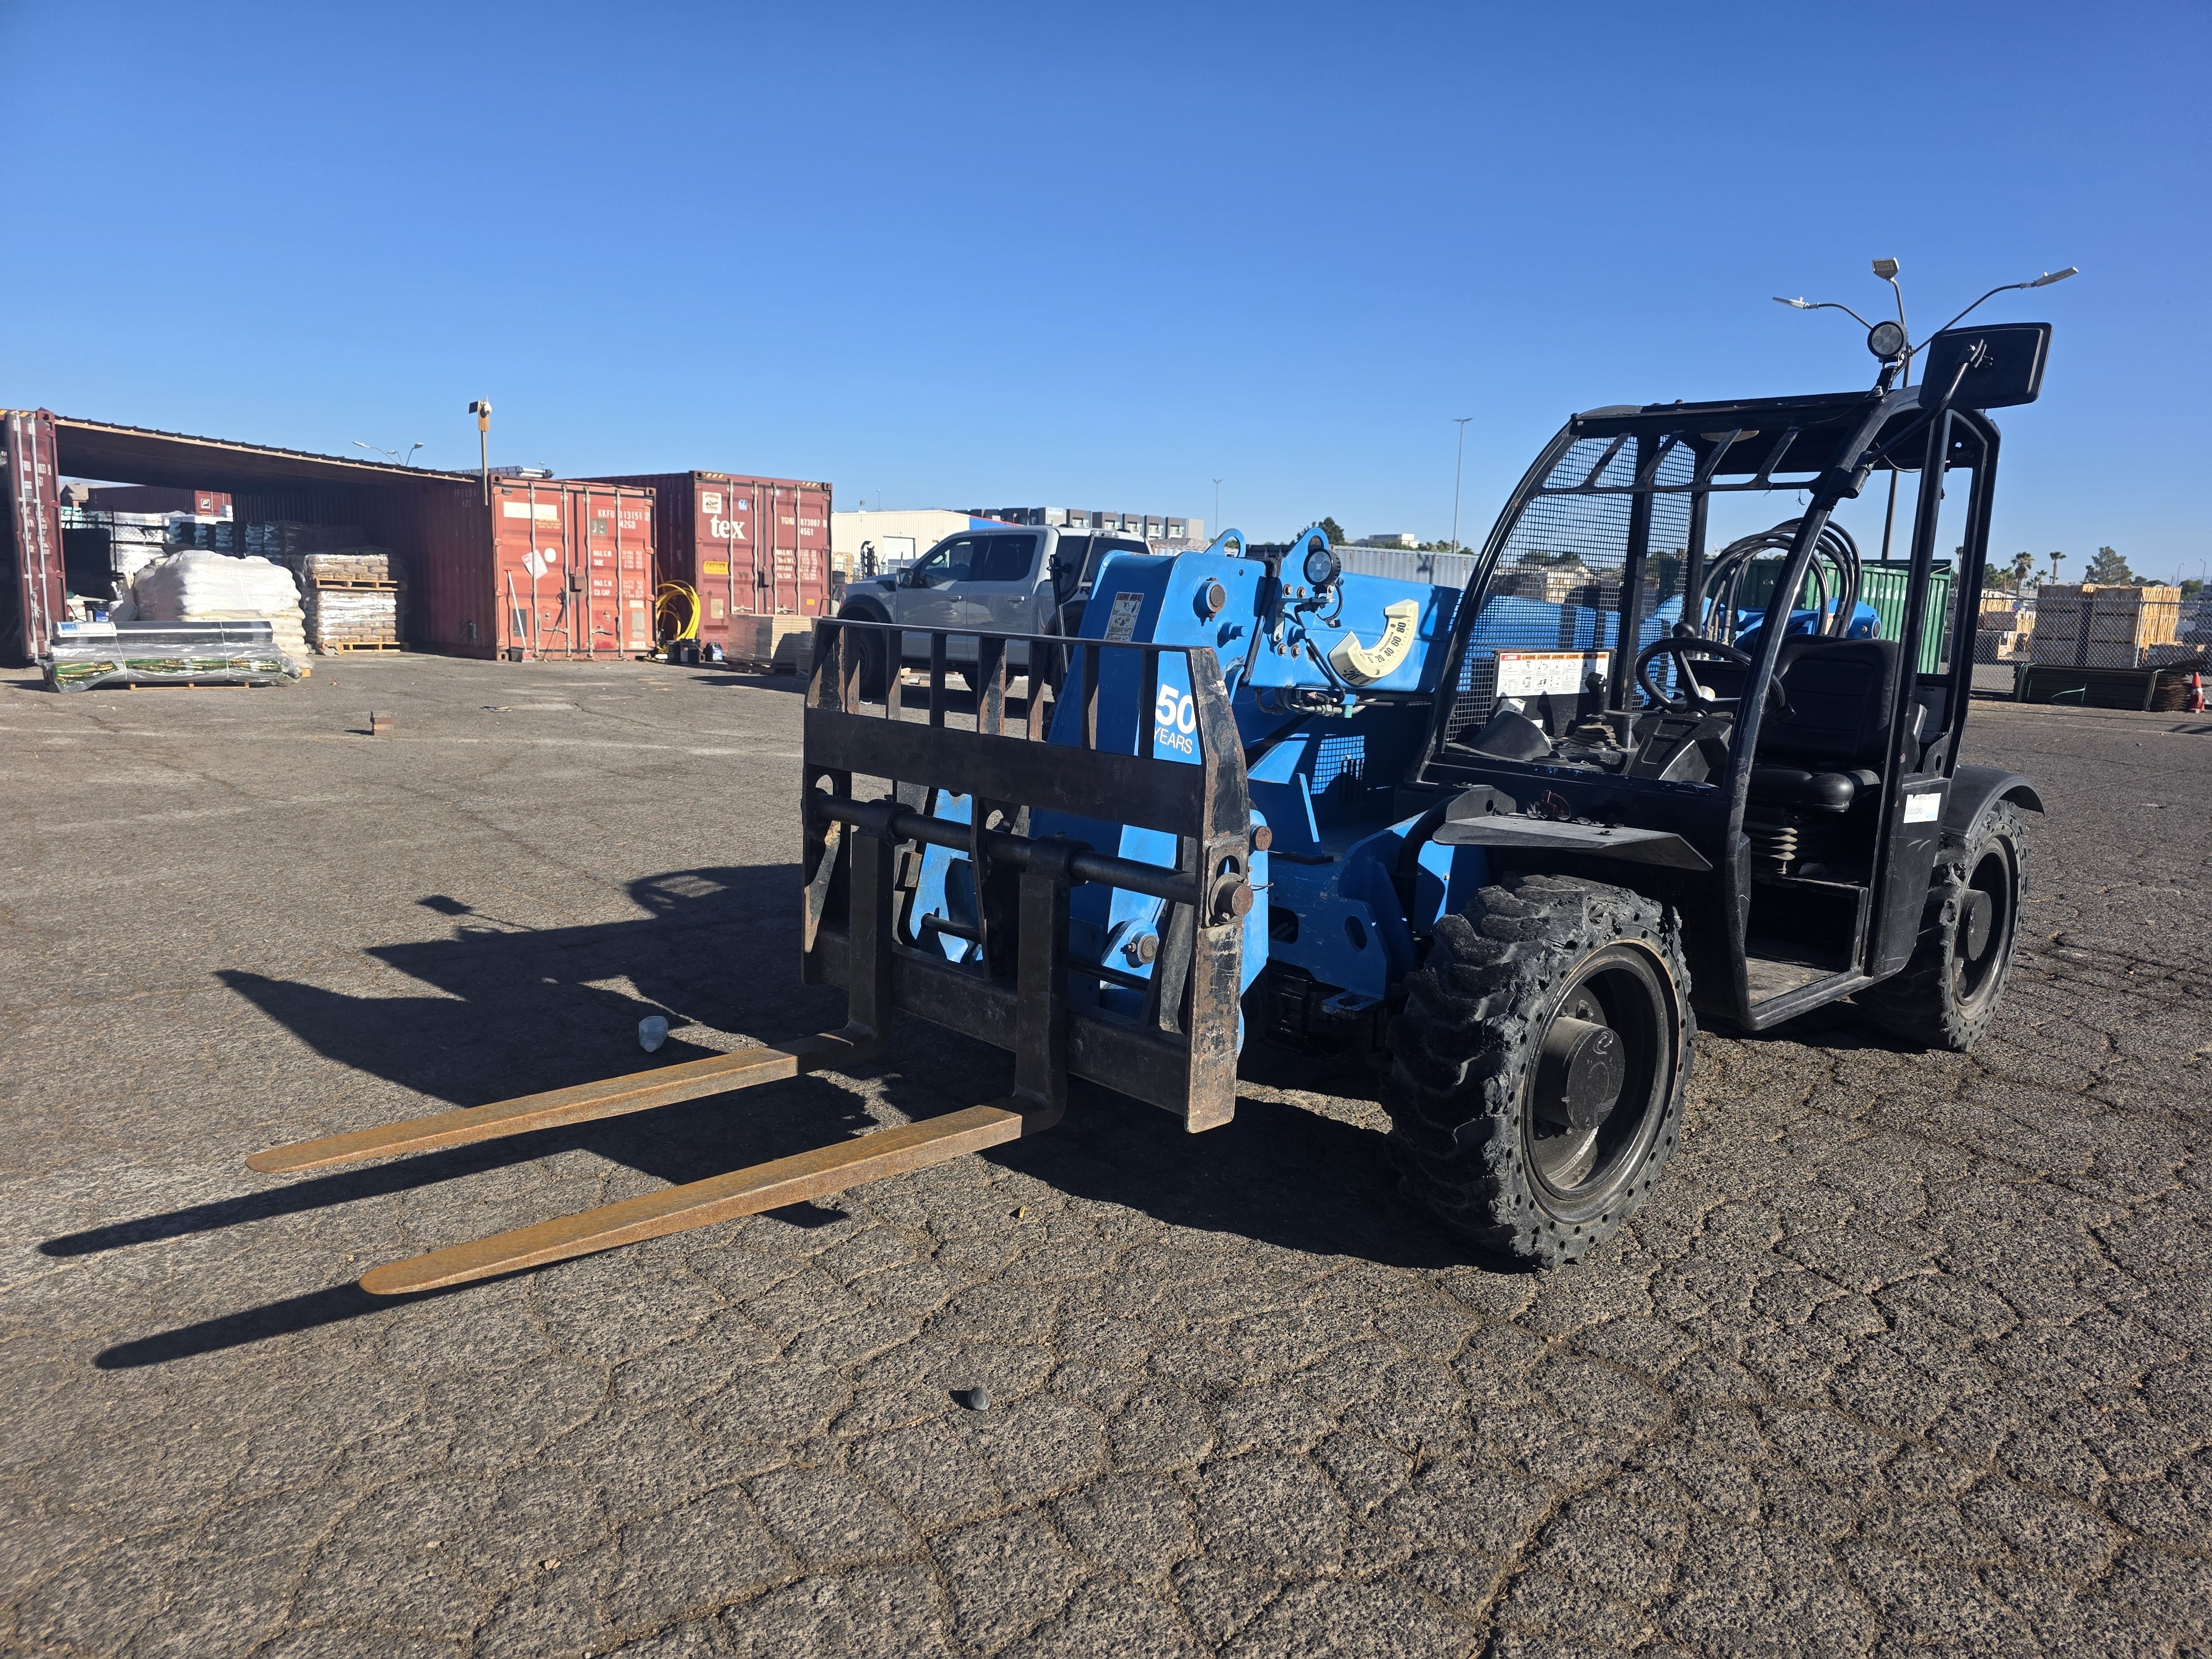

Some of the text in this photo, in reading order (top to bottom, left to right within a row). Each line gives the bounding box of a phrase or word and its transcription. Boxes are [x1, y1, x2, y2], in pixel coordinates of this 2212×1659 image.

[598, 509, 615, 518] KKFU
[619, 510, 642, 520] 113151
[710, 514, 746, 540] tex
[781, 516, 795, 525] TGHU
[800, 518, 820, 527] 873007
[1396, 622, 1406, 633] 80
[1391, 636, 1401, 647] 60
[1384, 647, 1394, 657] 40
[1375, 654, 1385, 663] 20
[1155, 684, 1196, 734] 50
[1154, 727, 1193, 754] YEARS
